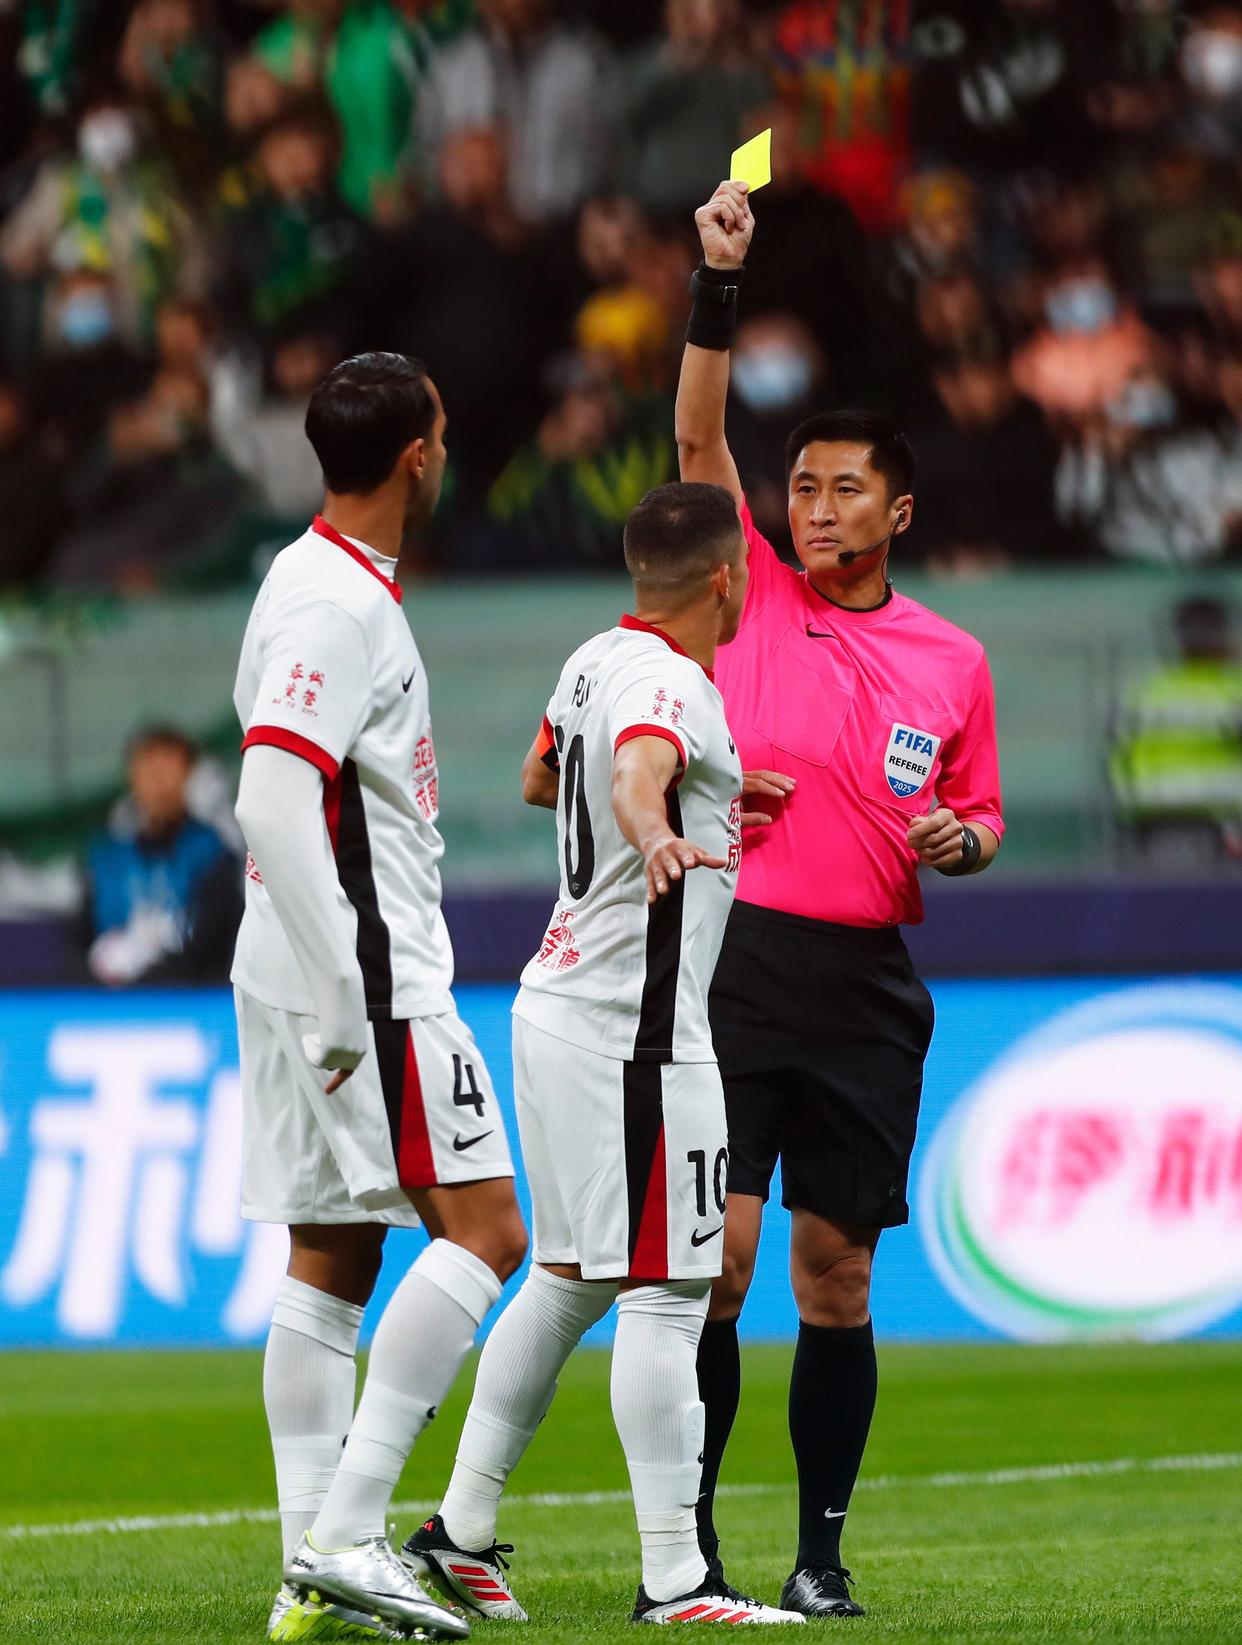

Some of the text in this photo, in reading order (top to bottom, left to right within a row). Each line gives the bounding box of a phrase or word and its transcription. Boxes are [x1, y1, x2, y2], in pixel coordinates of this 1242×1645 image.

[894, 728, 934, 757] FIFA
[888, 755, 928, 776] REFEREE
[893, 781, 912, 793] 2025
[451, 1052, 486, 1118] 4
[687, 1146, 730, 1217] 10
